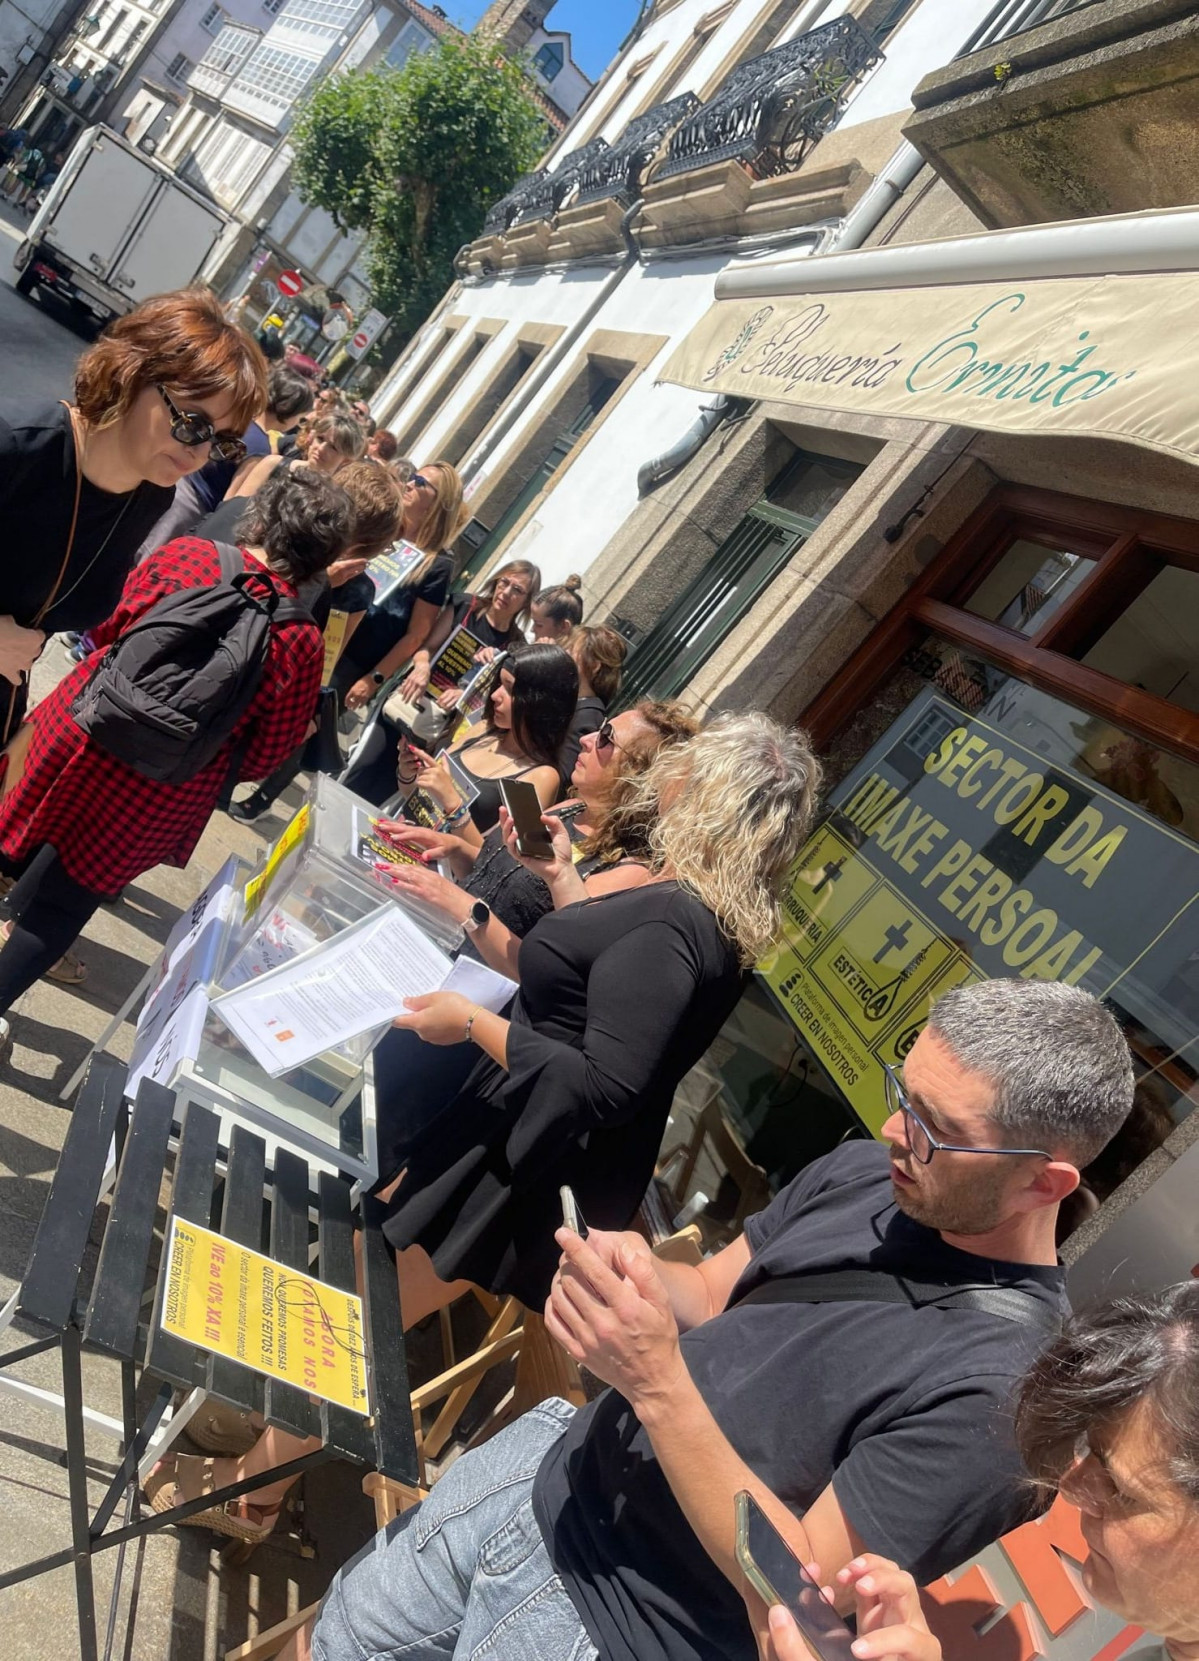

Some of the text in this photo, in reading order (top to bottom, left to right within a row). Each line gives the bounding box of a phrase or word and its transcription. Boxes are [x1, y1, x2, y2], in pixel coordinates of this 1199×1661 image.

[740, 303, 903, 393] Peluquería
[446, 647, 473, 671] QUEREMO
[843, 772, 950, 875] IMAXE
[924, 727, 1129, 889] SECTOR DA
[833, 953, 889, 1018] ESTÉTICA
[790, 993, 859, 1087] CREER EN NOSOTROS
[802, 982, 870, 1073] Plataforma de imagen personal
[184, 1247, 194, 1275] Plataforma
[240, 1251, 251, 1259] O
[240, 1257, 249, 1275] sector
[165, 1241, 184, 1324] CREER EN NOSOTROS
[179, 1282, 189, 1303] imagen
[204, 1242, 226, 1342] IVE ao 10% XA !!!
[239, 1274, 250, 1284] da
[239, 1282, 249, 1301] imaxe
[177, 1302, 187, 1330] personal
[236, 1298, 248, 1328] personal
[260, 1266, 274, 1367] QUEREMOS FEITOS !!!
[277, 1289, 287, 1329] QUEREMOS
[236, 1331, 247, 1361] esencial
[277, 1329, 287, 1371] PROMESAS
[320, 1312, 335, 1367] AGORA
[348, 1333, 356, 1346] DEZ
[303, 1356, 317, 1389] NOS
[350, 1364, 359, 1374] DE
[350, 1374, 360, 1399] ESPERA
